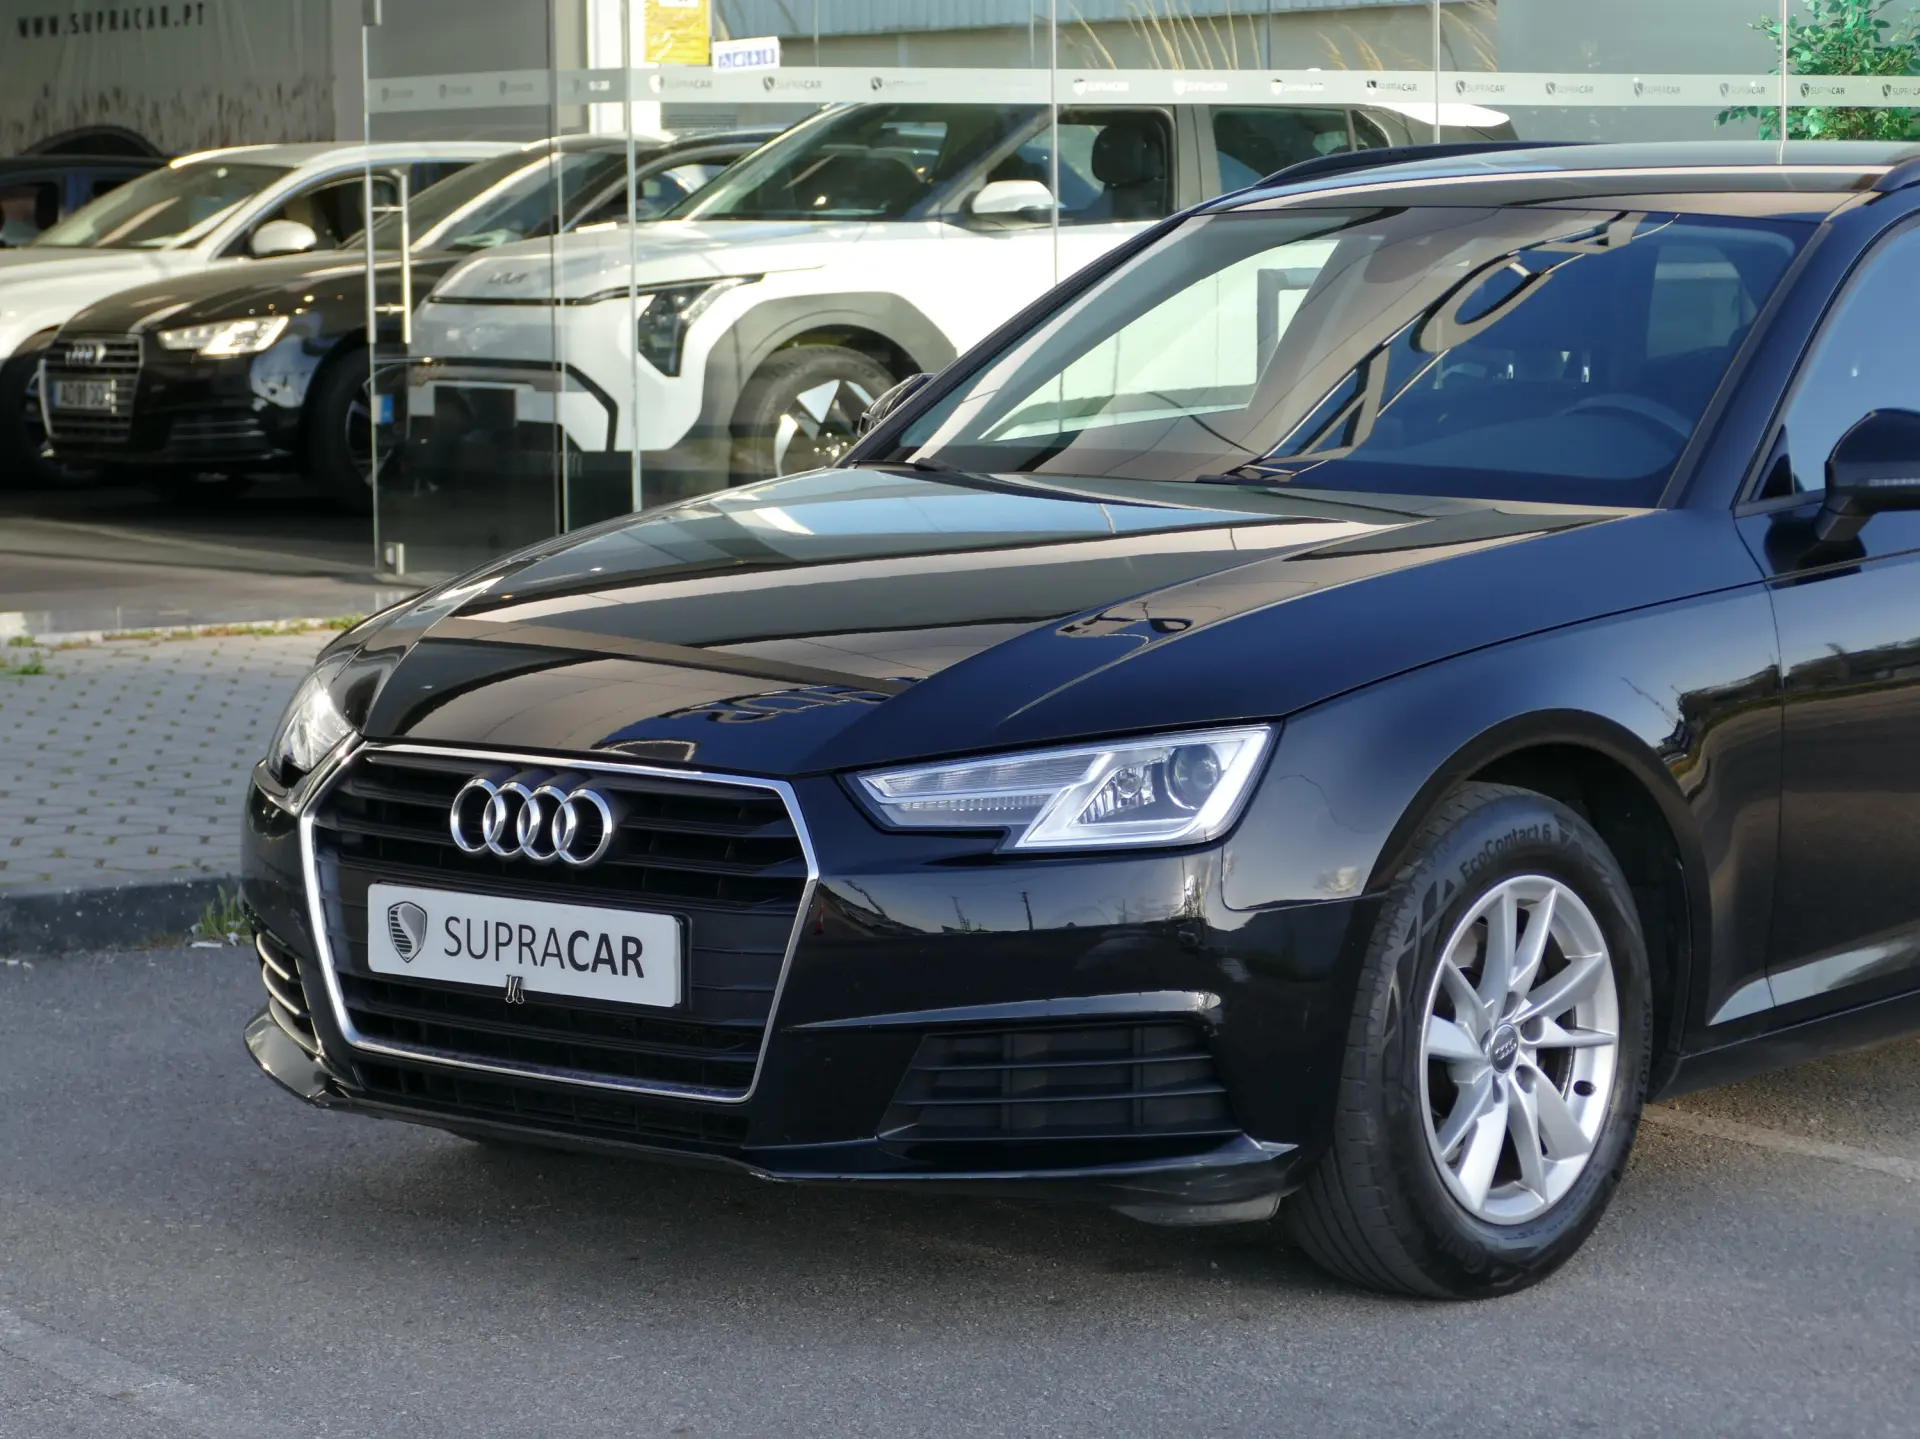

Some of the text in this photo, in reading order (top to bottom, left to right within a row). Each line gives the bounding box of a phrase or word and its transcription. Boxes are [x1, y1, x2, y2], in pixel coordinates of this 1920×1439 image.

[17, 2, 204, 38] WWW.SUPRACAR.PT
[1459, 823, 1552, 880] EcoContact 6
[444, 915, 645, 979] SUPRACAR
